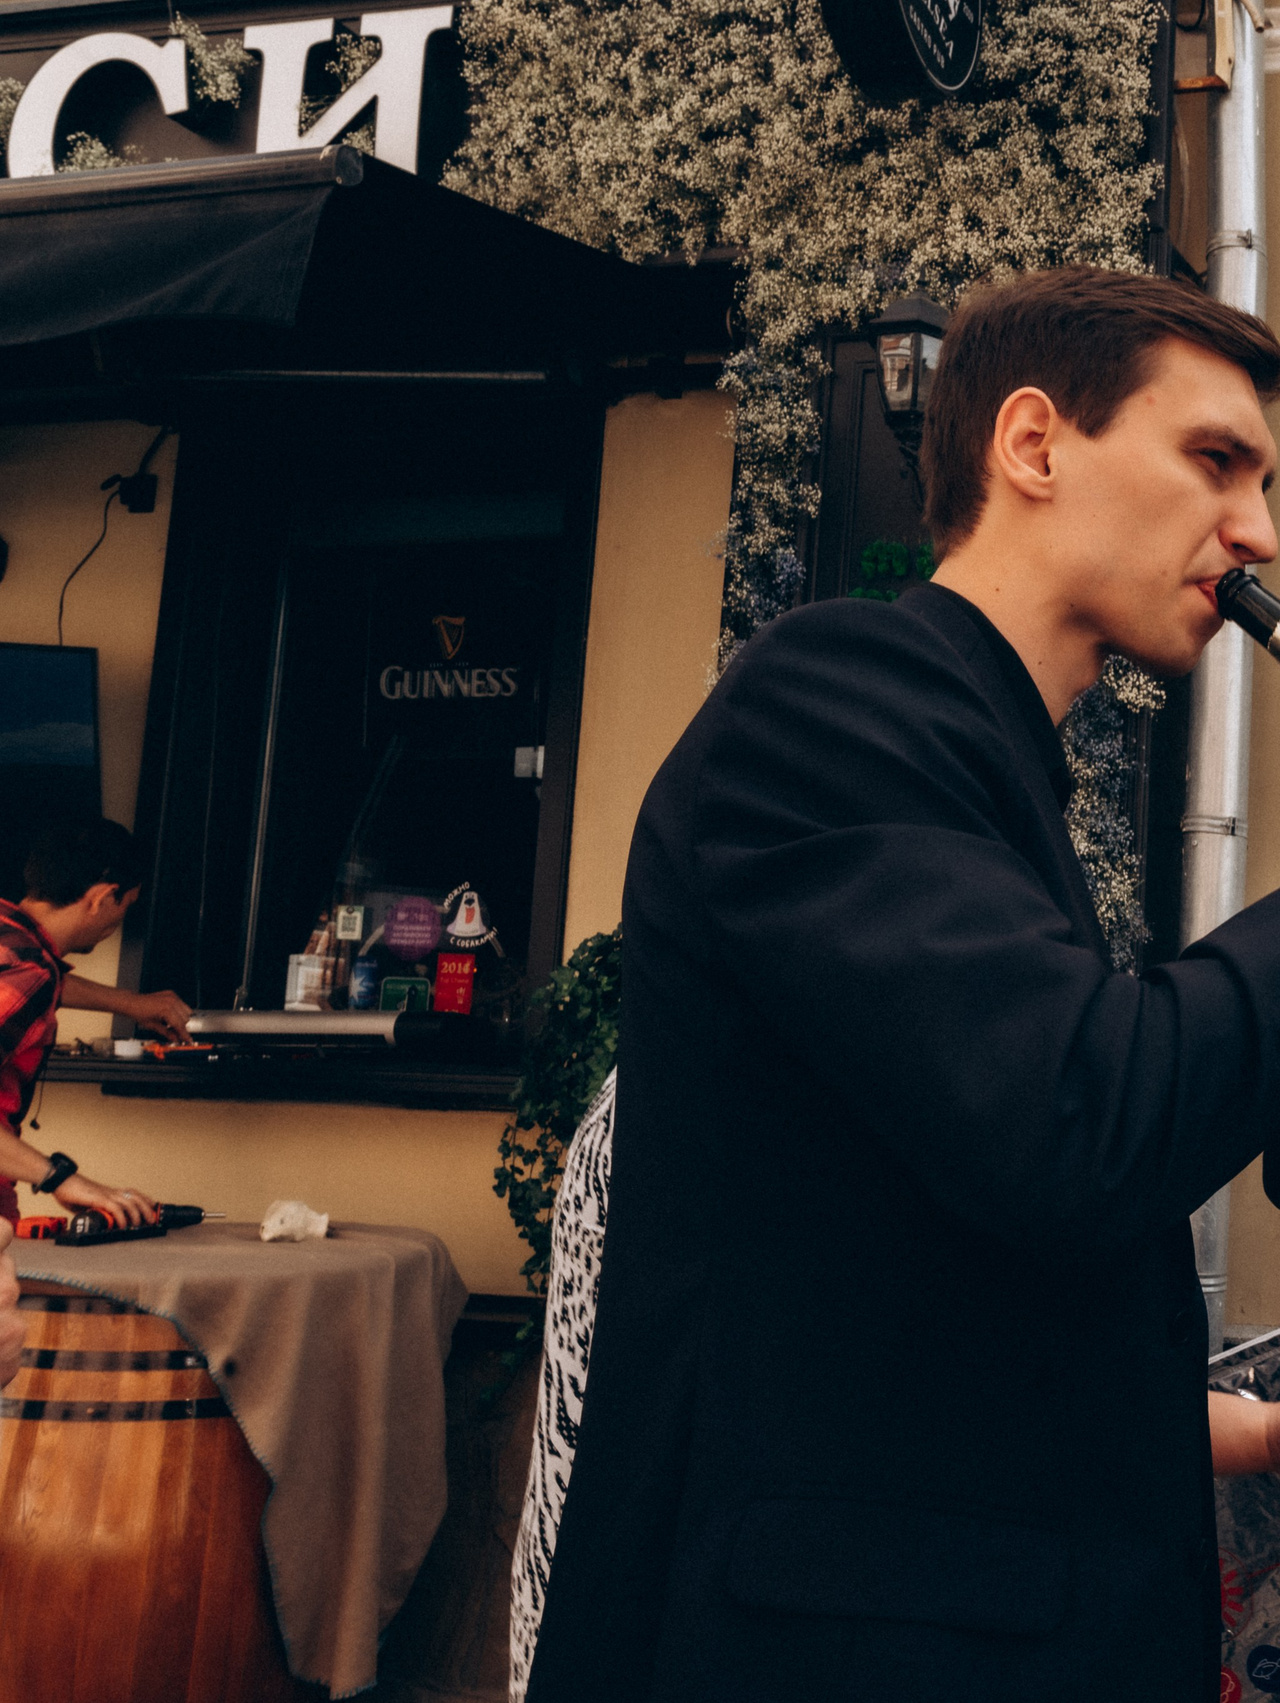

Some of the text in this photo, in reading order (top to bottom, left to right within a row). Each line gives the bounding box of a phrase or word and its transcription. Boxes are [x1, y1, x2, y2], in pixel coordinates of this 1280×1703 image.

[7, 5, 453, 178] СИ
[380, 665, 518, 699] GUINNESS
[443, 881, 471, 909] МОЖНО
